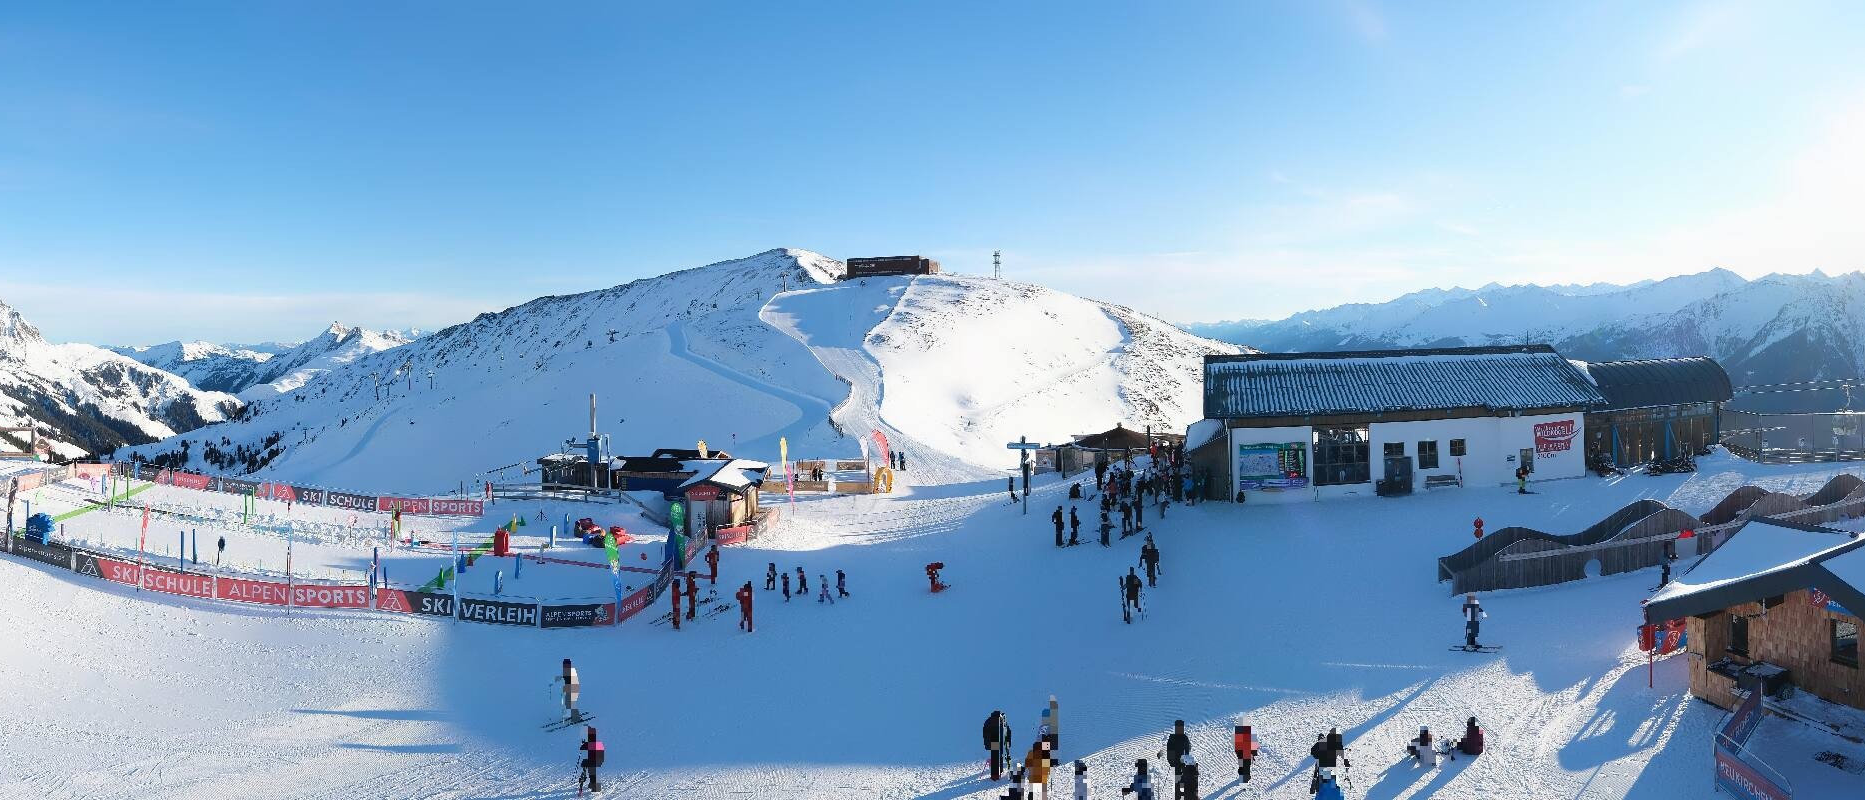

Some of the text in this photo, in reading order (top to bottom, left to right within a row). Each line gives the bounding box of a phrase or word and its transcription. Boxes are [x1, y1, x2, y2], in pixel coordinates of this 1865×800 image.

[302, 490, 322, 503] SKI
[329, 493, 374, 512] SCHULE
[433, 501, 481, 513] SPORTS
[112, 564, 366, 605] SKI SCHULE ALPEN SPORTS
[421, 597, 536, 624] SKI VERLEIH
